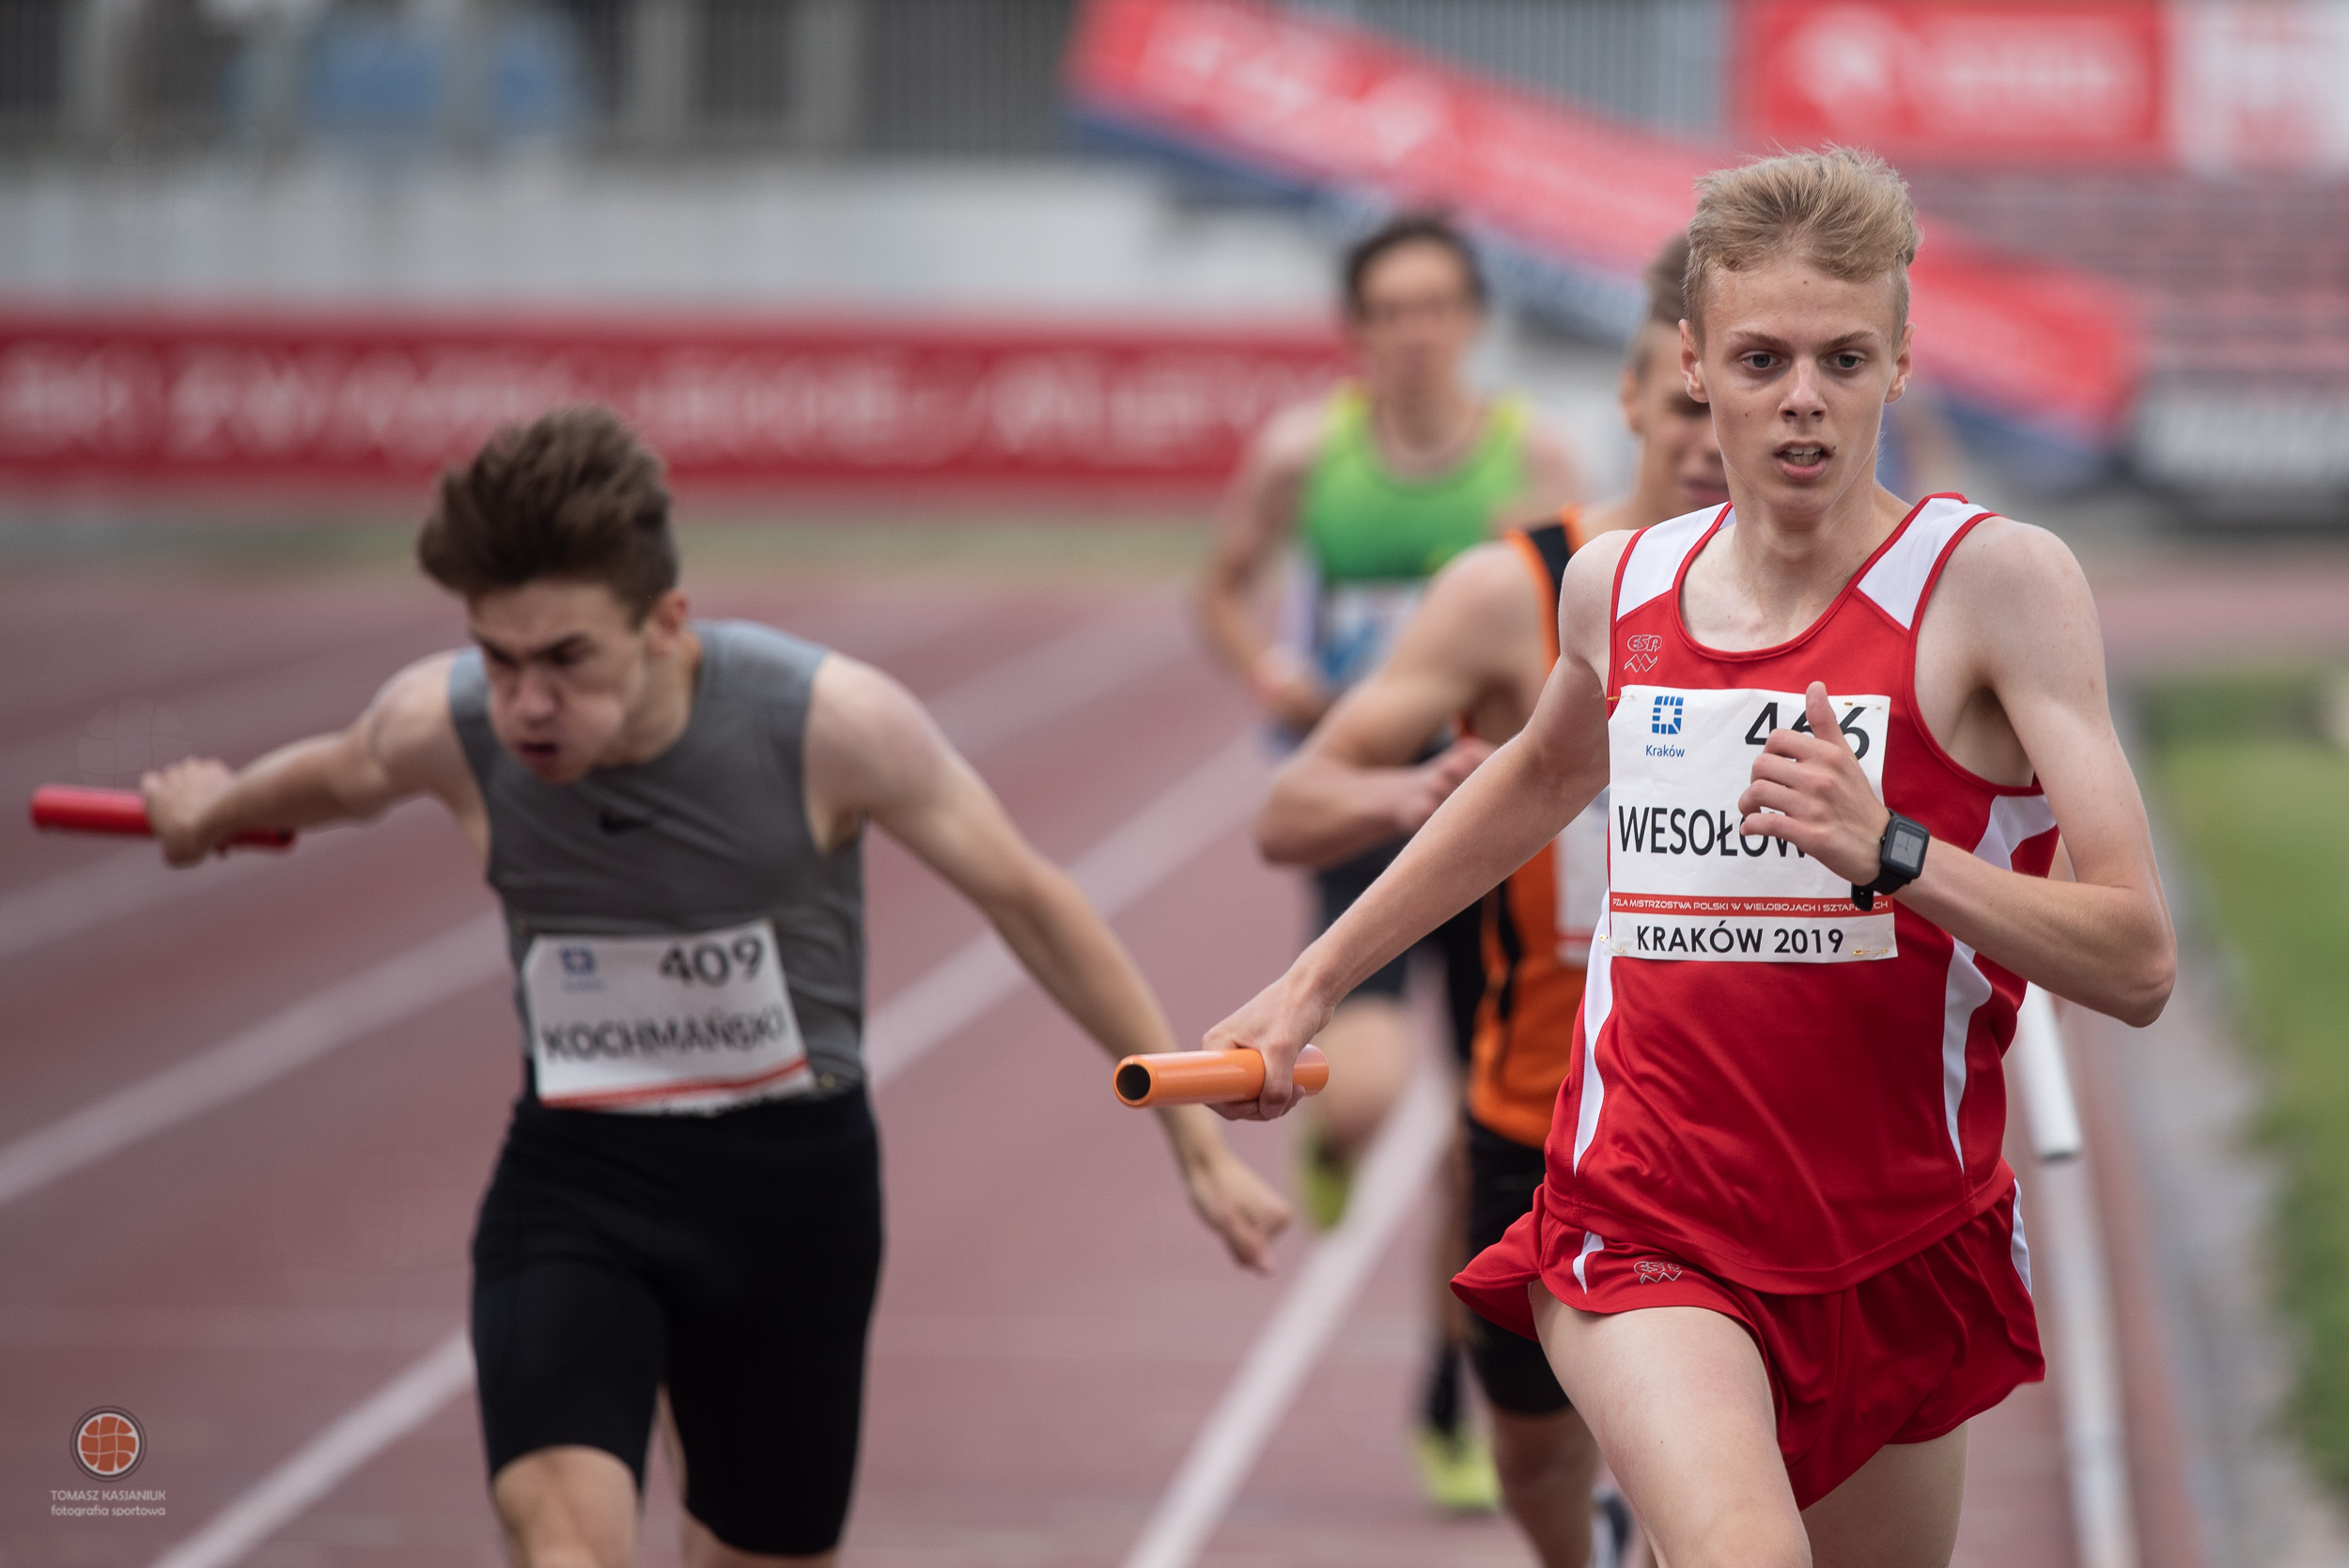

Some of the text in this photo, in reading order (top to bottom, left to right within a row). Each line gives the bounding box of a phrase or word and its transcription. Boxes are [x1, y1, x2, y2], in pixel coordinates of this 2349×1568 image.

[1645, 744, 1686, 758] Kraków
[1612, 897, 1628, 908] PZLA
[1629, 899, 1691, 910] MISTRZOSTWA
[1693, 903, 1729, 911] POLSKI
[1743, 903, 1815, 912] WIELOBOJACH
[1637, 920, 1843, 954] KRAKÓW 2019
[660, 935, 764, 984] 409
